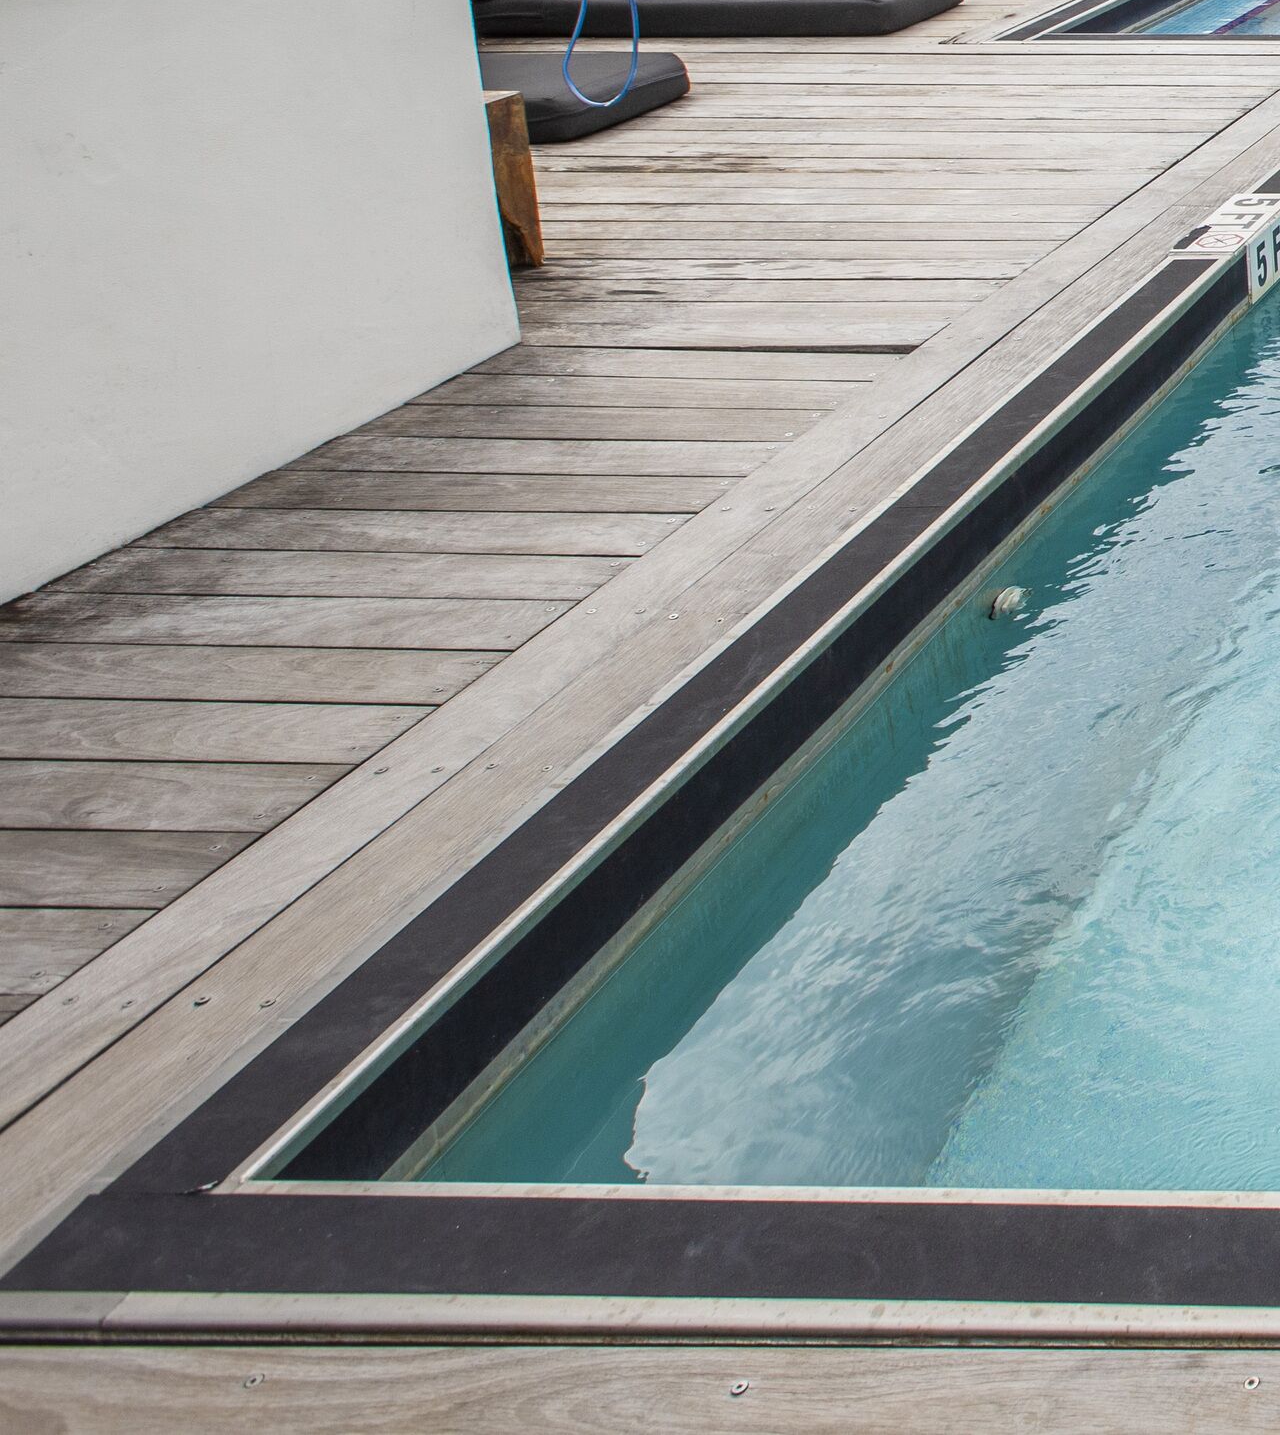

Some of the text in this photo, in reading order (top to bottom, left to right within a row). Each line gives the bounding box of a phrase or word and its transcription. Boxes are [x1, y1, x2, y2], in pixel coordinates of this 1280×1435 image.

[1209, 198, 1280, 230] 5 FT
[1256, 240, 1268, 287] 5
